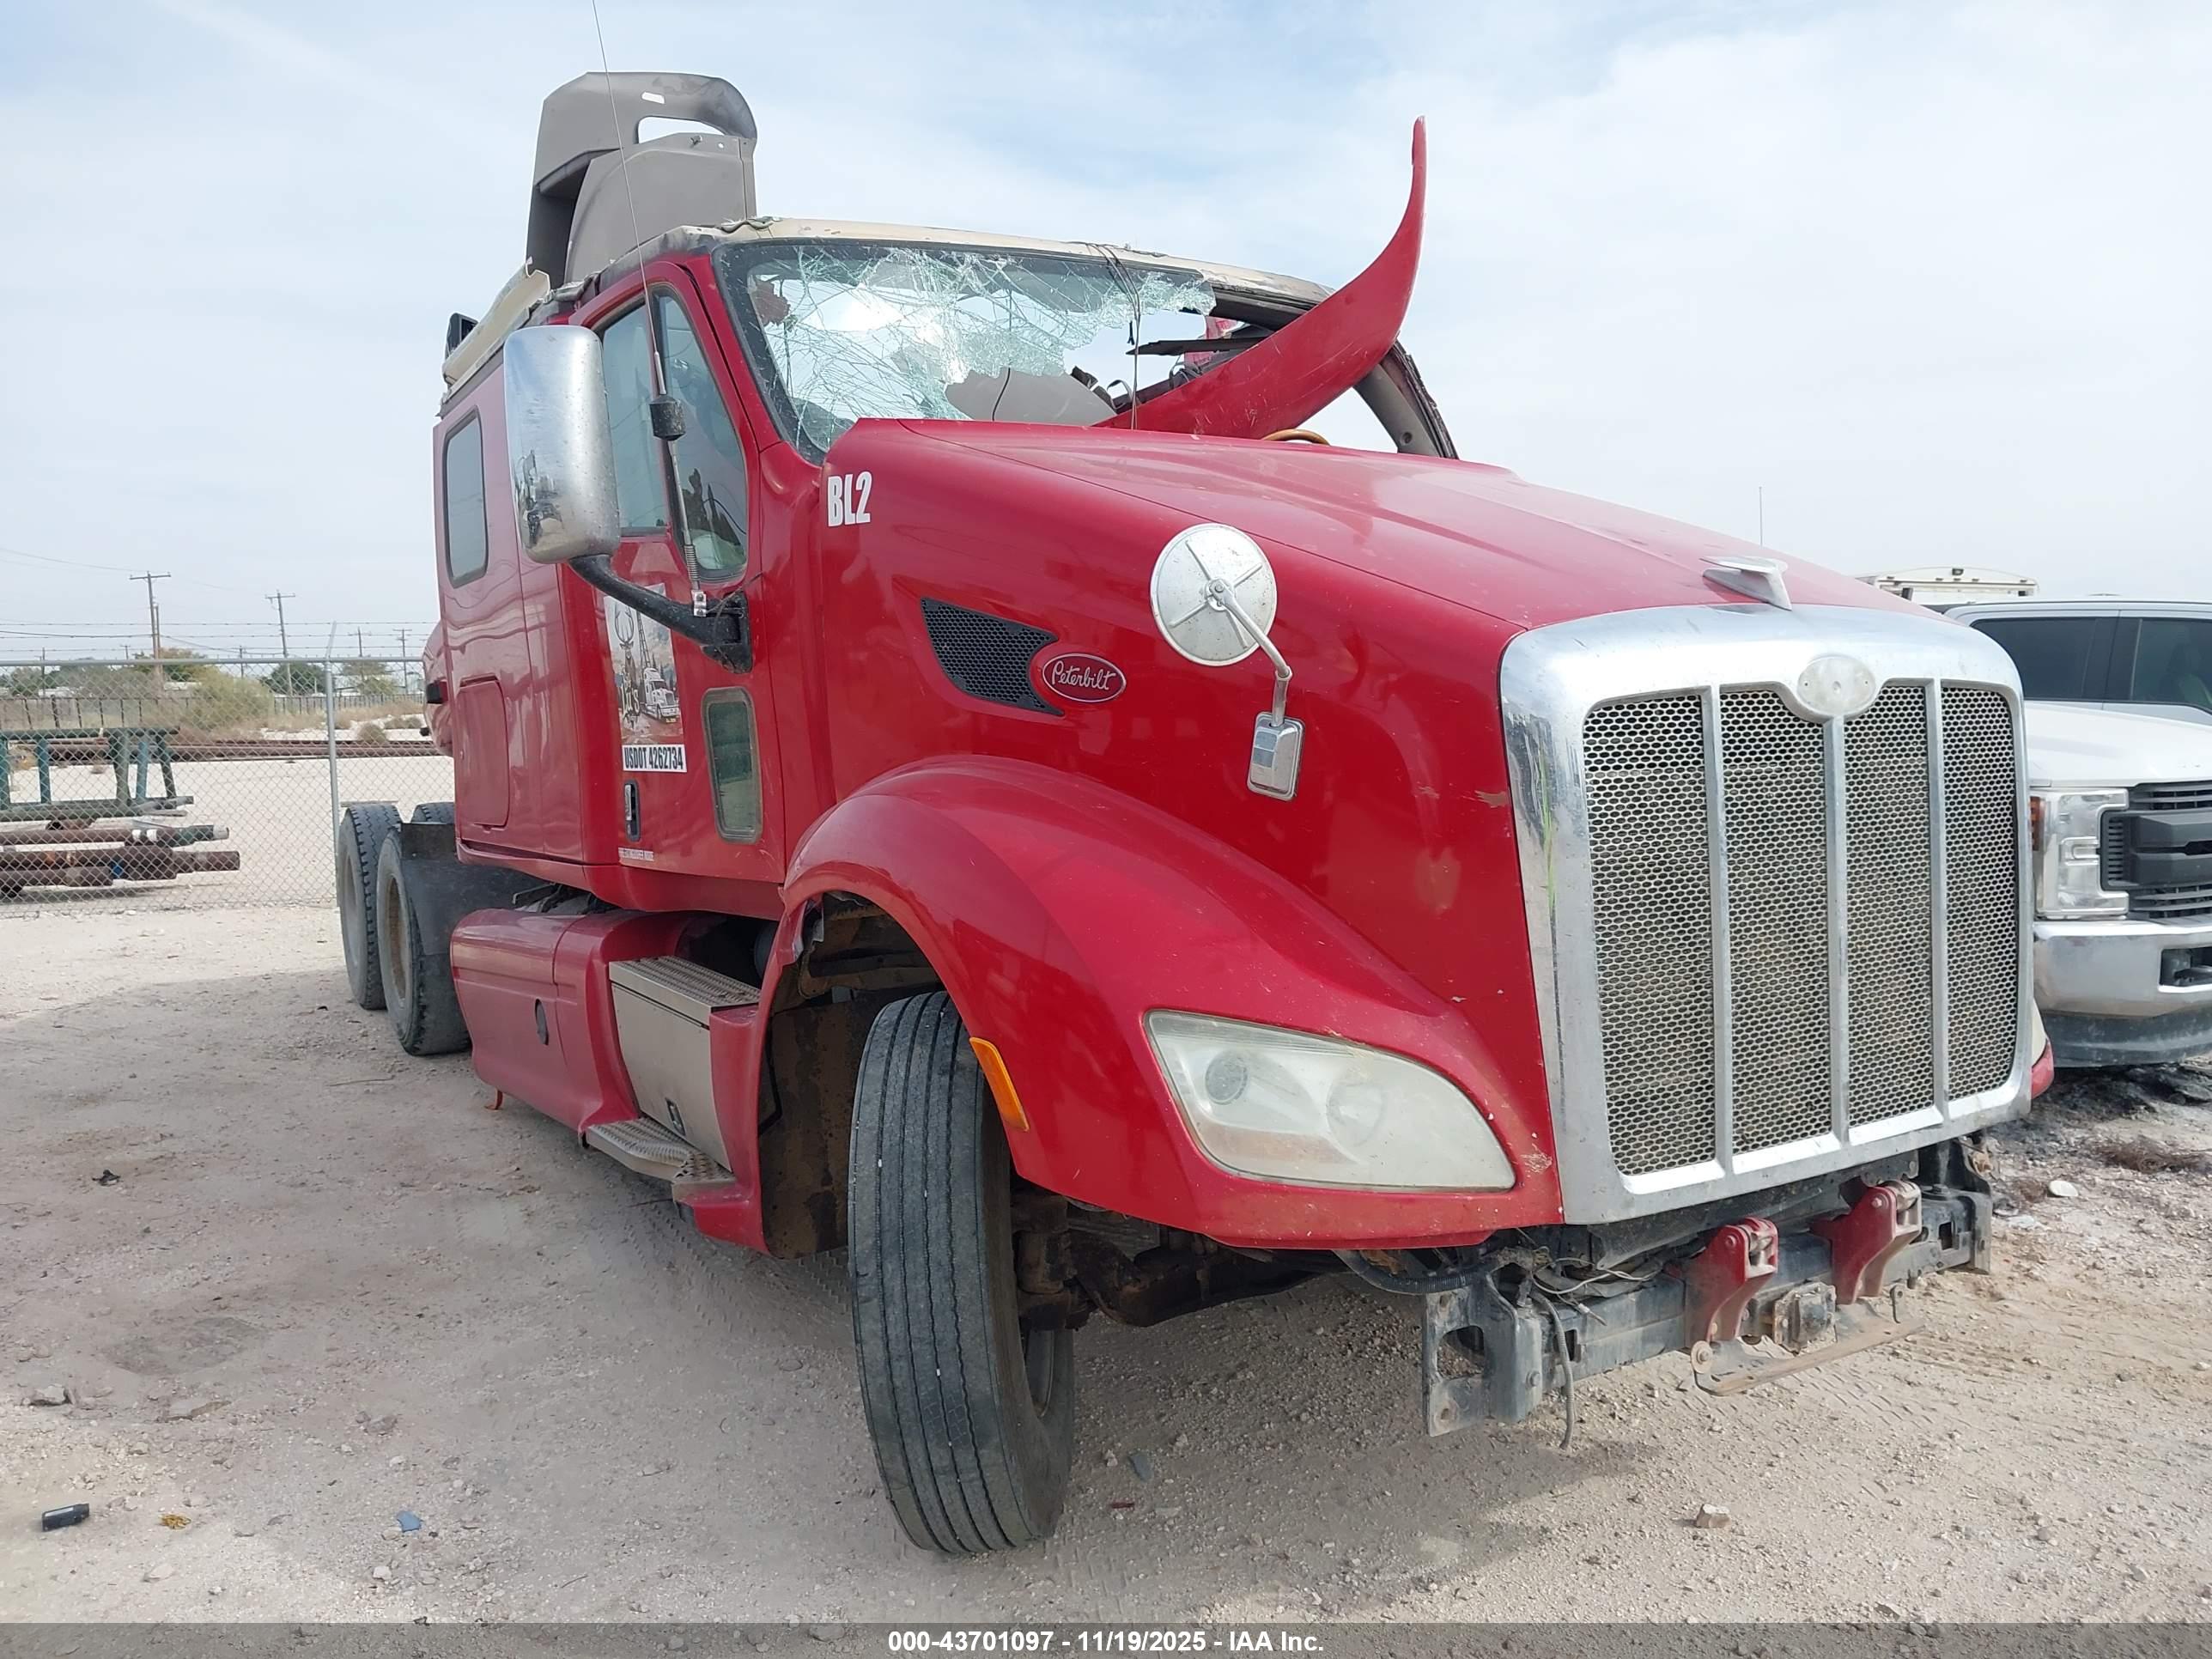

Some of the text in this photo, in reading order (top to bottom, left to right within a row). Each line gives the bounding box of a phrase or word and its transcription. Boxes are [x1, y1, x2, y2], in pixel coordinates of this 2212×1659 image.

[828, 471, 872, 526] BL2
[1052, 660, 1116, 690] Peterbilt
[623, 746, 684, 769] USDOT 4262734
